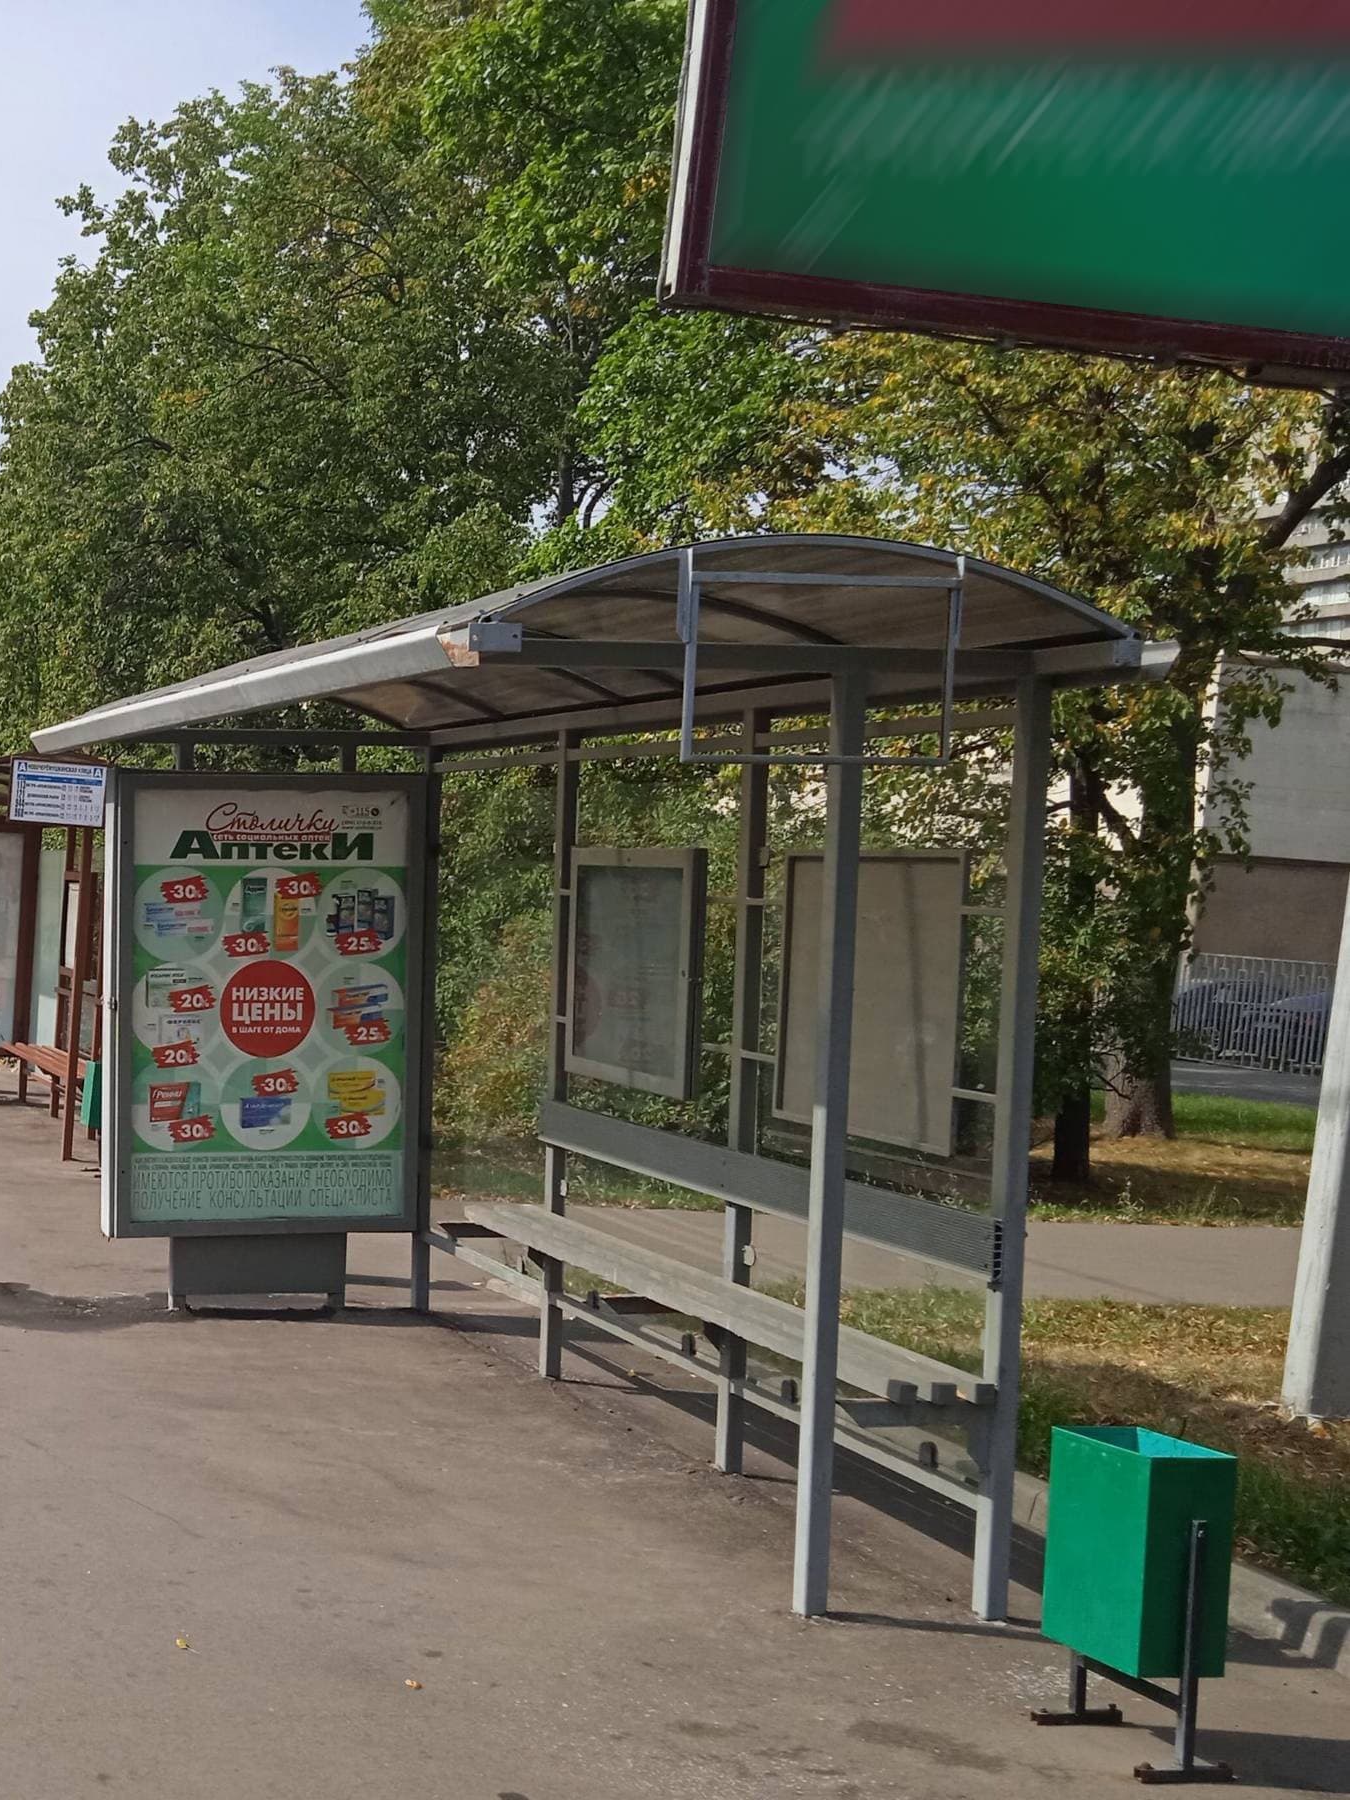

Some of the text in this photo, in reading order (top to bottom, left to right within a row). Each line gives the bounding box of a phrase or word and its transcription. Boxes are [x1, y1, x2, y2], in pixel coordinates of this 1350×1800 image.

[205, 802, 339, 831] Столички
[236, 834, 299, 842] социальных
[231, 986, 305, 1001] НИЗКИЕ
[231, 1002, 304, 1025] ЦЕНЫ
[231, 1026, 302, 1035] В ШАГЕ ОТ ДОМА
[133, 1168, 392, 1191] ИМЕЮТСЯ ПРОТИВОПОКАЗАНИЯ НЕОБХОДИМО
[133, 1187, 392, 1210] ПОЛУЧЕНИЕ КОНСУЛЬТАЦИИ СПЕЦИАЛИСТА
